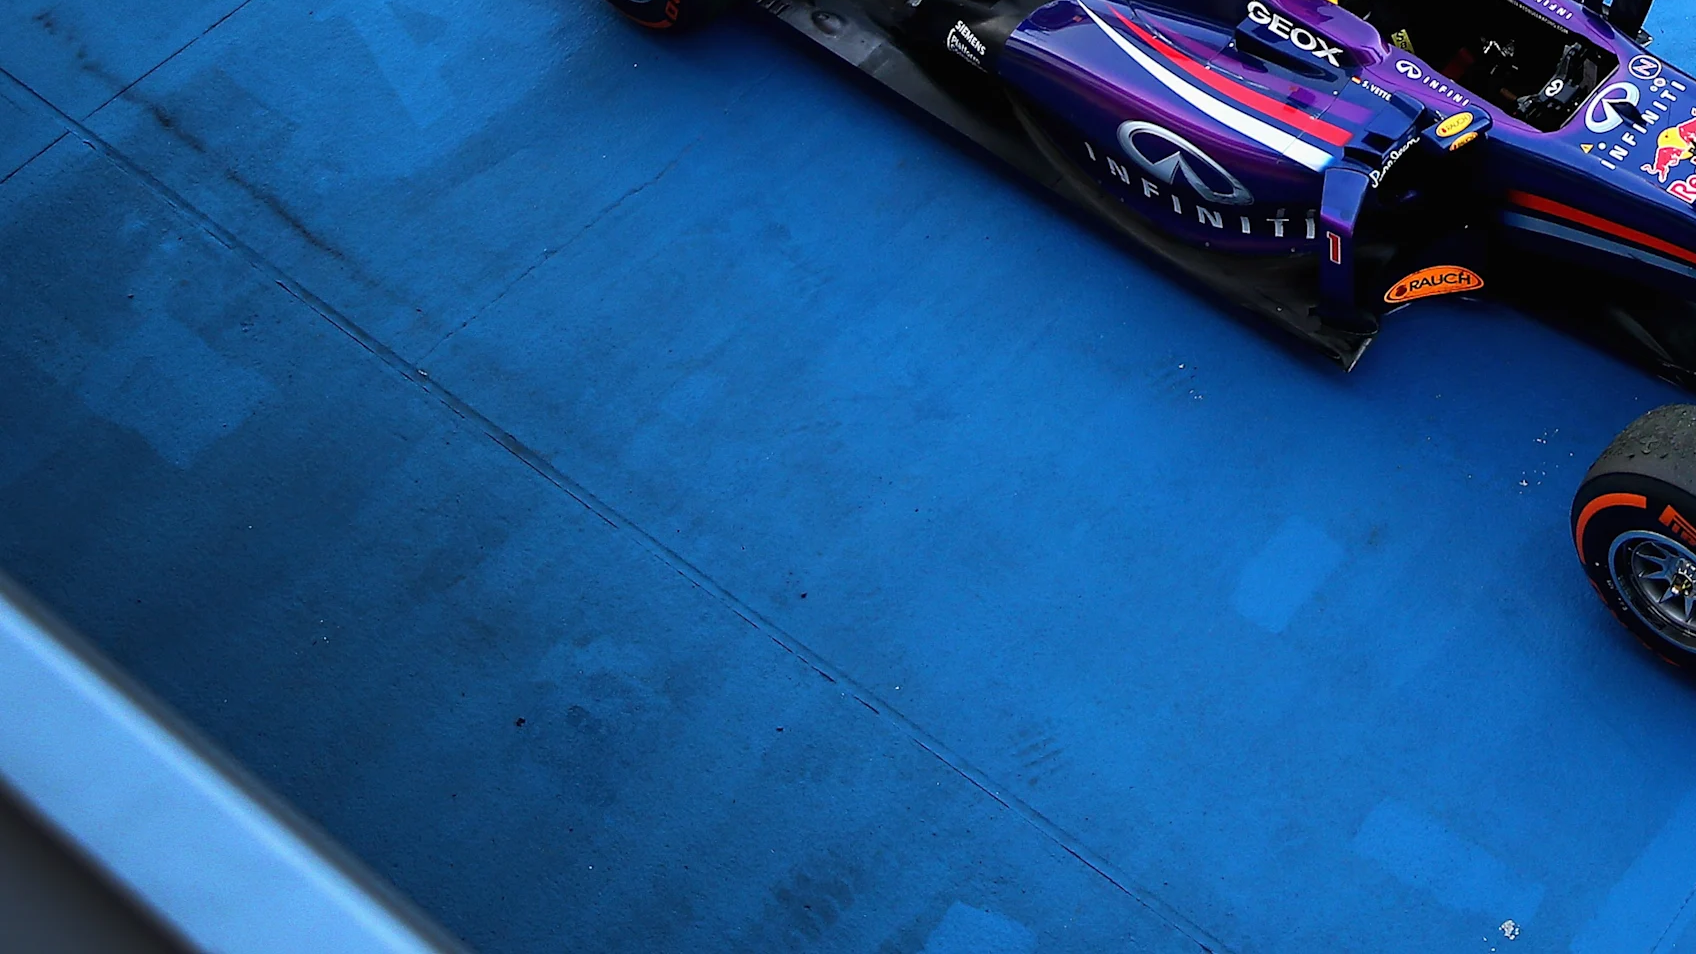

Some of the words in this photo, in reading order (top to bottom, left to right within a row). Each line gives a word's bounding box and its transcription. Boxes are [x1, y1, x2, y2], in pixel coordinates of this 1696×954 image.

[955, 20, 987, 55] SIEMENS
[1247, 1, 1344, 68] GEOX
[1422, 76, 1471, 107] INFINI
[1600, 80, 1686, 171] INFINITI
[1084, 141, 1317, 240] INFINITI
[1326, 231, 1342, 265] 1
[1409, 271, 1471, 291] RAUCH
